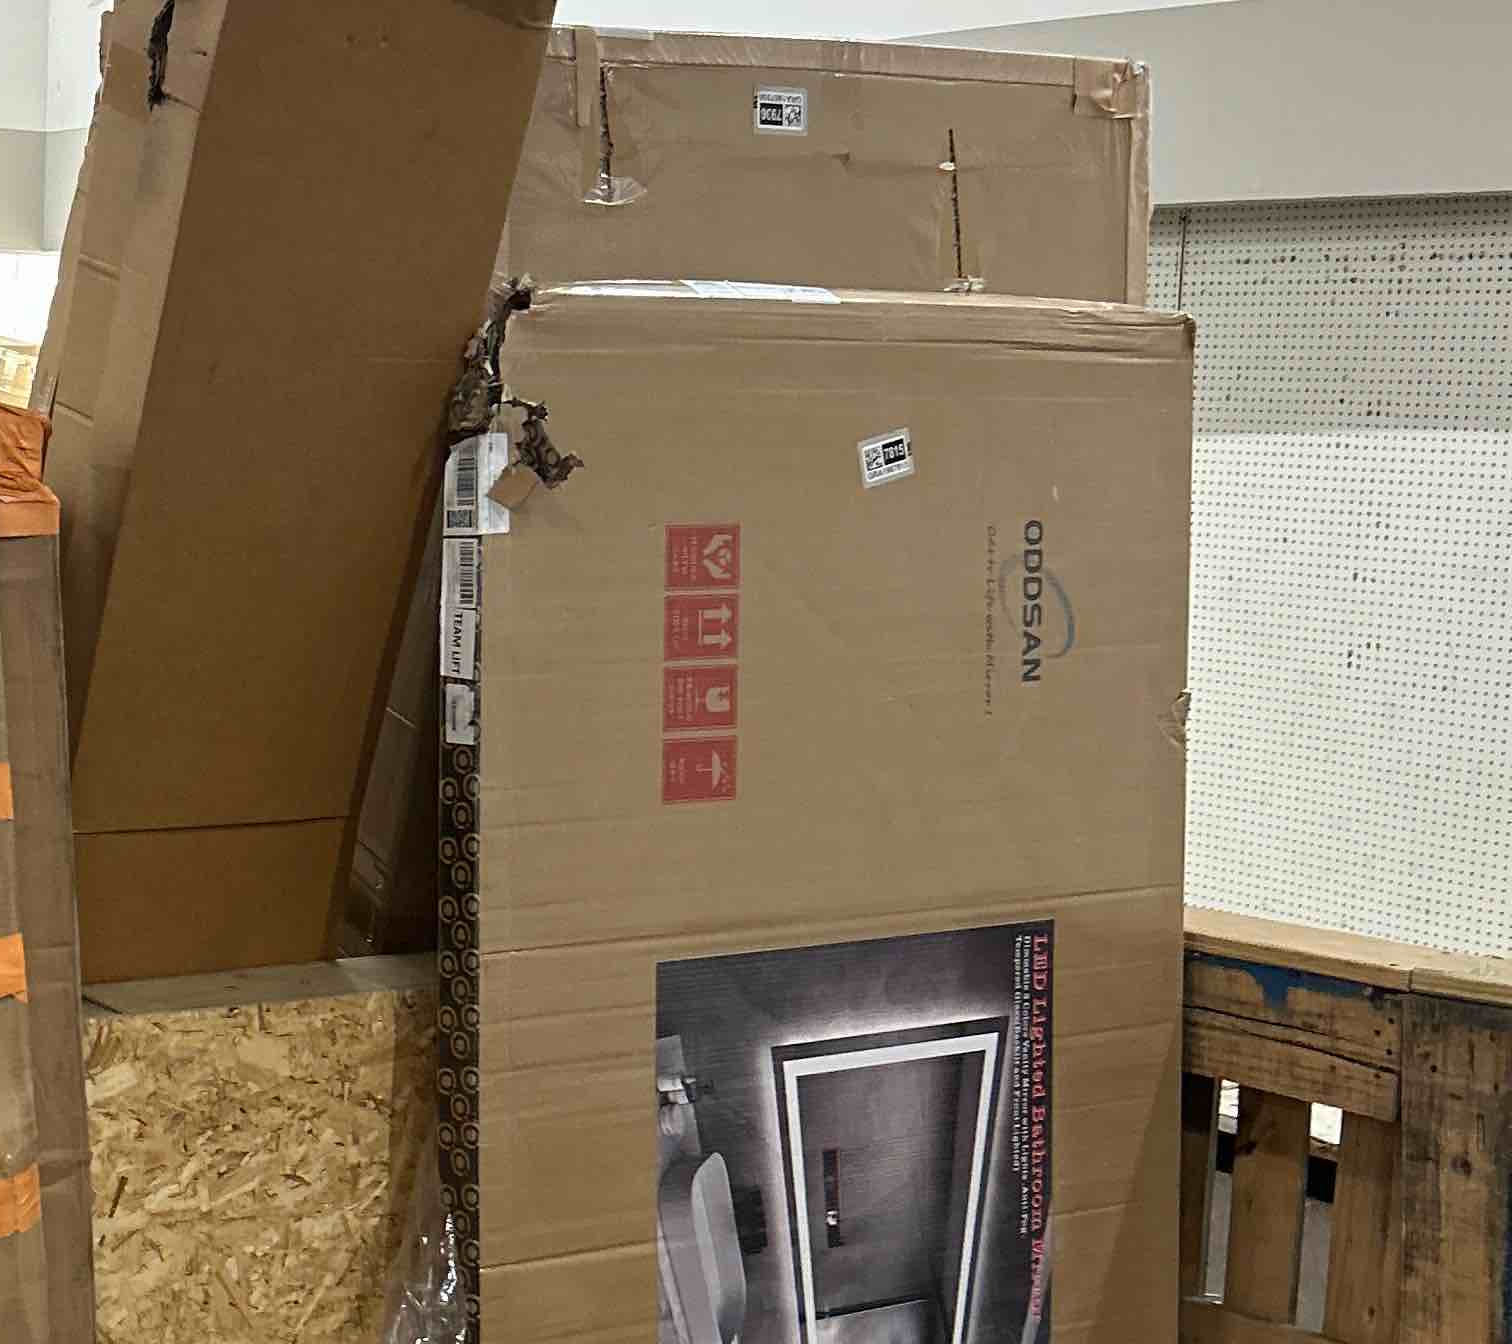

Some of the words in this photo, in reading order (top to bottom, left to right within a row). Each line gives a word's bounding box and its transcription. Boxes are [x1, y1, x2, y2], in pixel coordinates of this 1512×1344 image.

[452, 612, 464, 648] TEAM
[1021, 519, 1044, 683] ODDSAN
[450, 651, 462, 675] LIFT
[1032, 935, 1049, 991] LED
[1029, 997, 1049, 1098] Lighted
[1031, 1105, 1048, 1233] Bathroom
